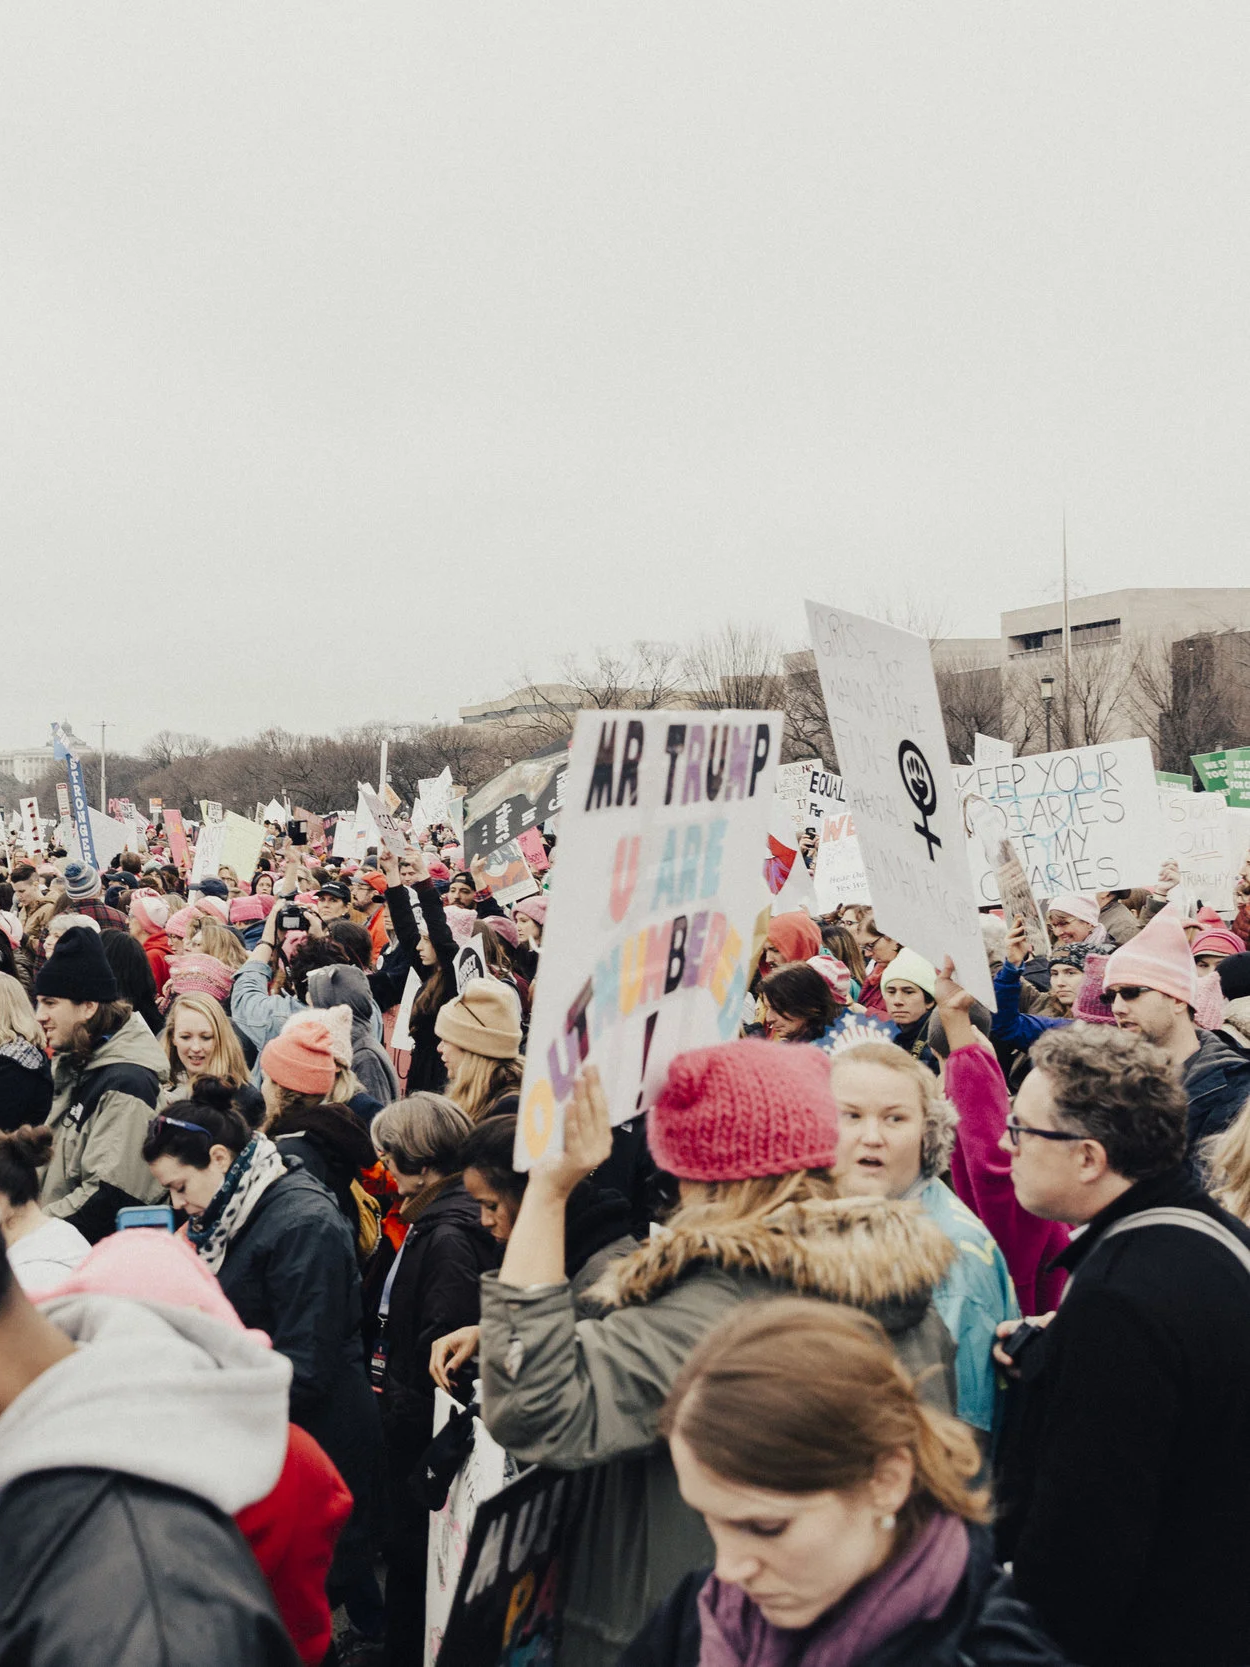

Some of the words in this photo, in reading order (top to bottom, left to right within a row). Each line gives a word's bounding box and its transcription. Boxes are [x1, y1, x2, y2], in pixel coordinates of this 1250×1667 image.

[586, 720, 644, 812] MR
[665, 723, 771, 808] TRUMP
[809, 770, 846, 803] EQUAL
[1035, 751, 1122, 796] YOUR
[68, 757, 94, 864] STRONGER
[495, 802, 513, 844] there
[1054, 827, 1089, 862] MY
[1176, 827, 1221, 855] OUT
[609, 835, 640, 923] U
[651, 818, 728, 912] ARE
[980, 856, 1121, 902] OARIES
